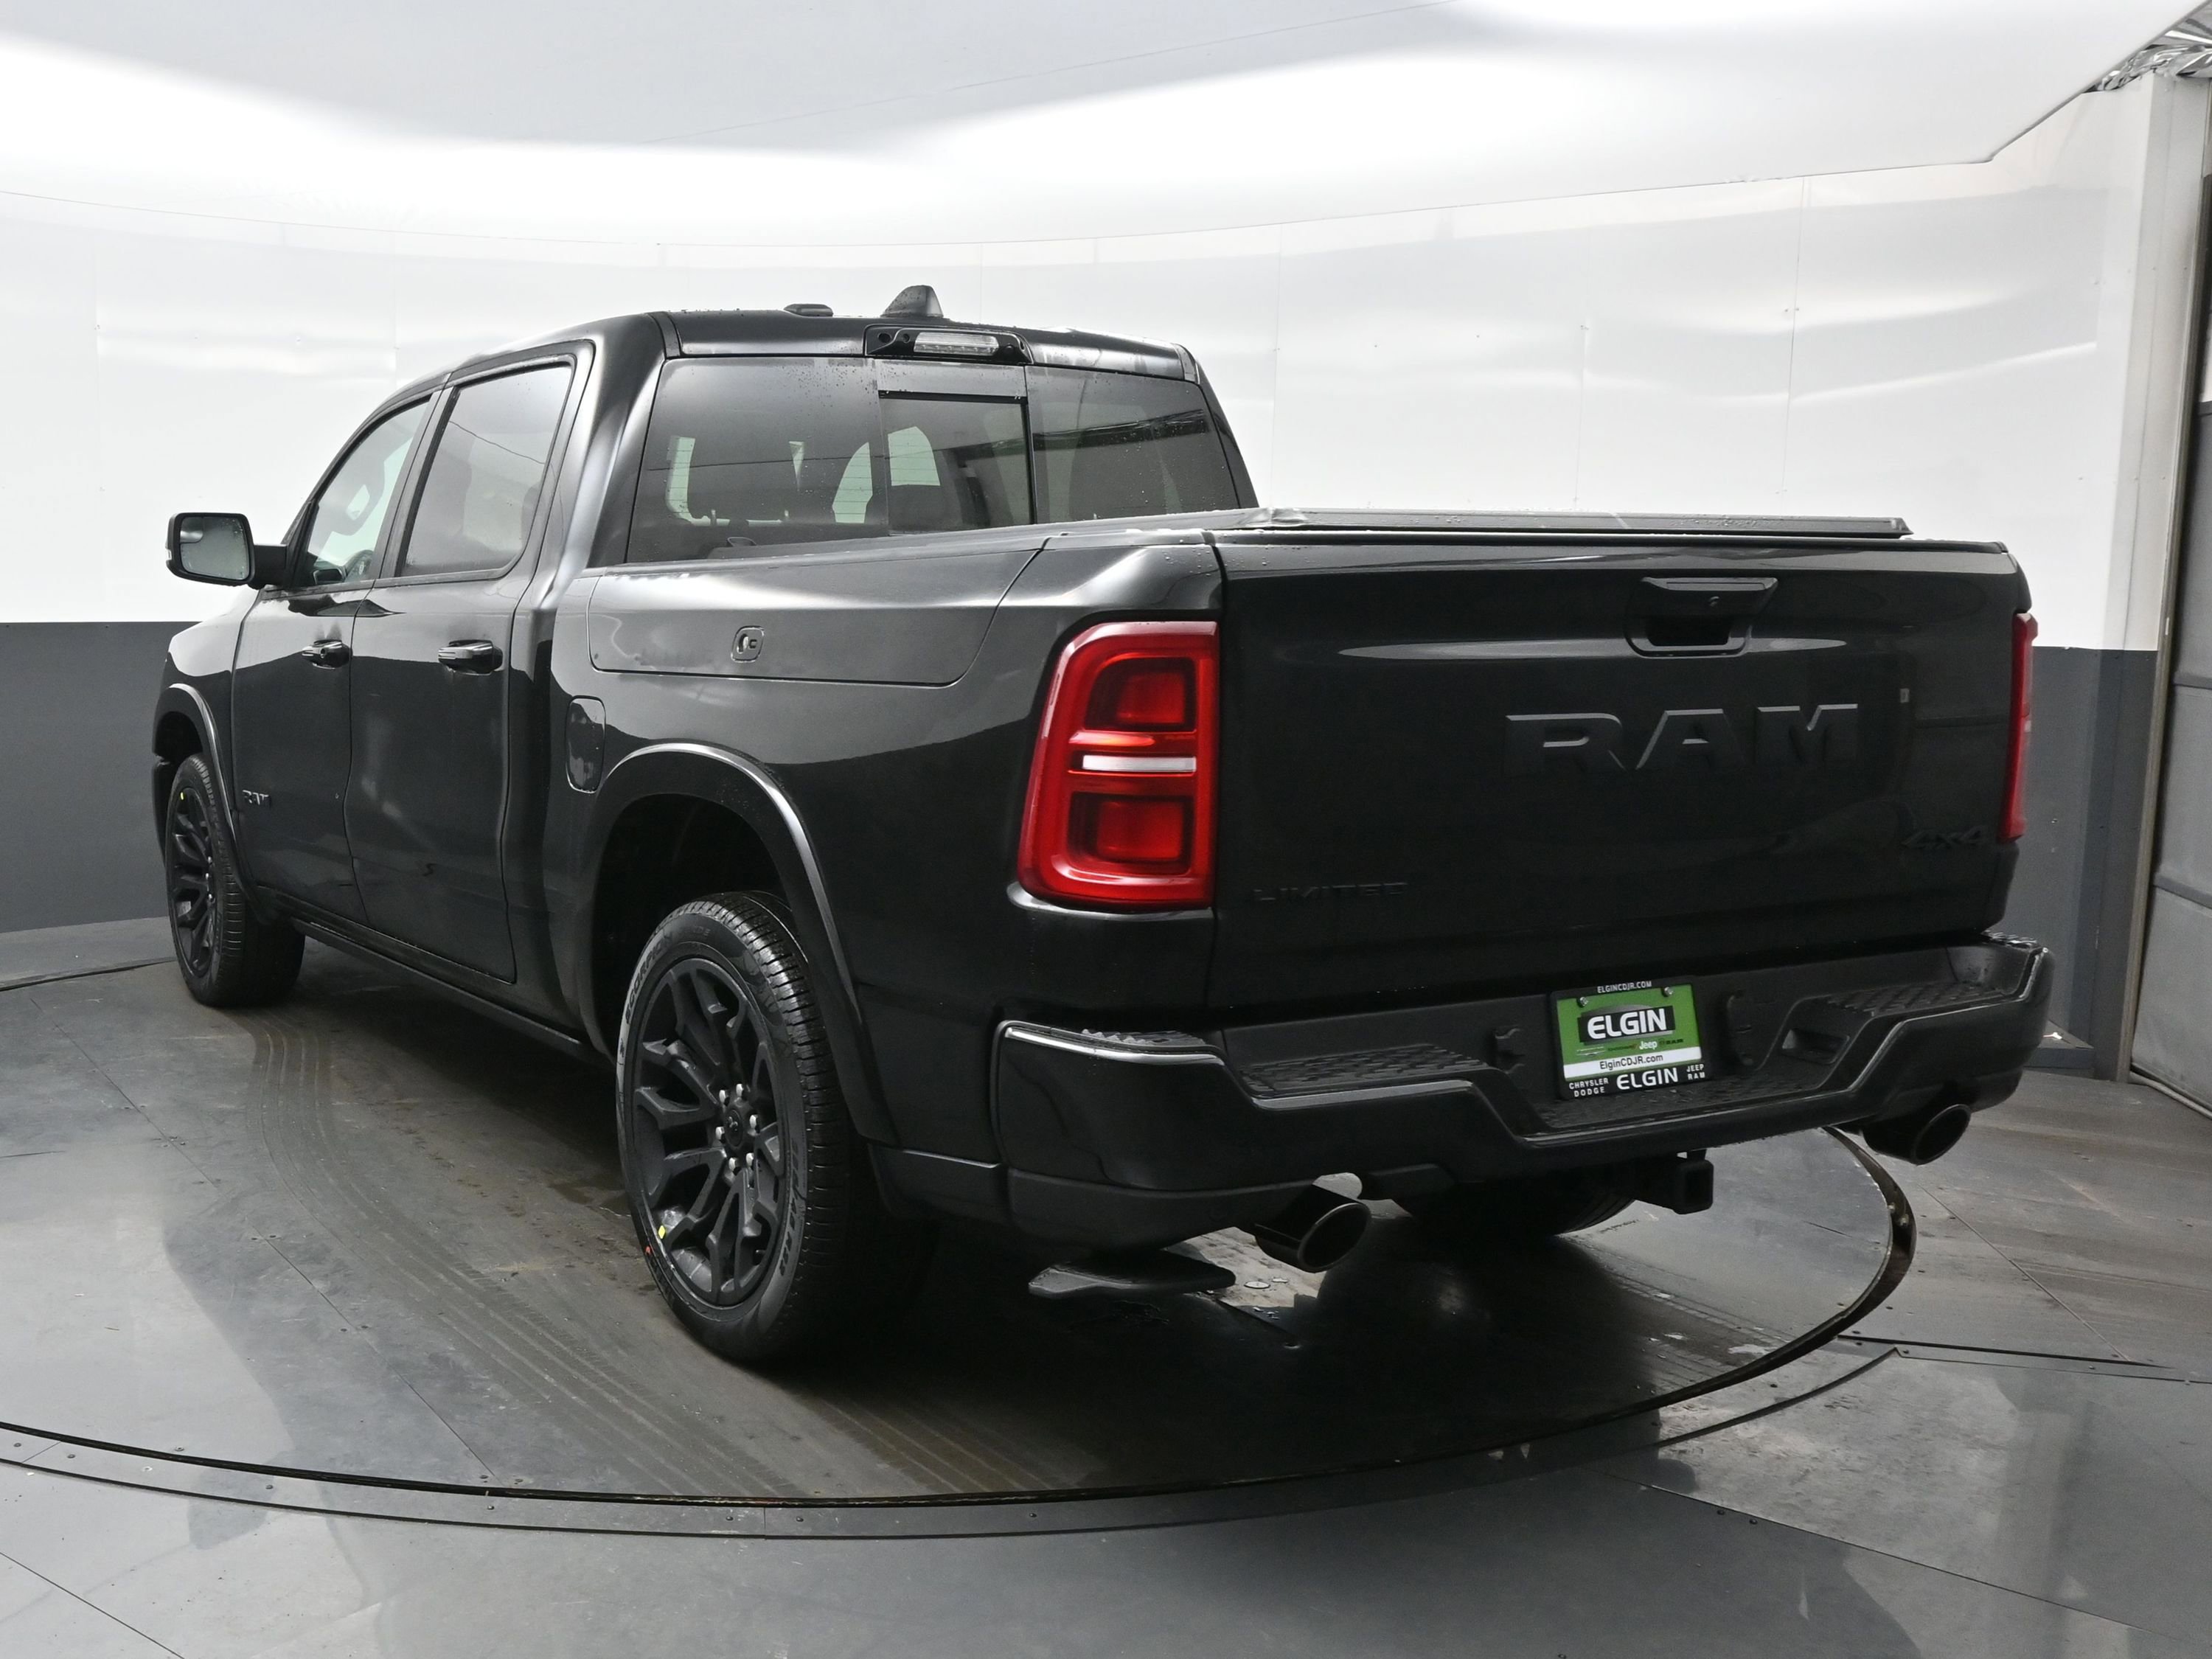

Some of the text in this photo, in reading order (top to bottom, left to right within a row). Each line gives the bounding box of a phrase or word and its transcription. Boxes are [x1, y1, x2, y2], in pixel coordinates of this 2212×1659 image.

[1503, 703, 1859, 777] RAM
[1253, 882, 1409, 902] LIMITED
[1596, 981, 1652, 994] ELGINCDJR.COM
[1587, 1008, 1667, 1040] ELGIN
[1639, 1040, 1658, 1051] Jeep
[1599, 1054, 1664, 1071] ElginCDJR.com
[1686, 1064, 1705, 1073] JEEP
[1616, 1067, 1679, 1091] ELGIN
[1687, 1071, 1706, 1081] RAM
[1568, 1077, 1610, 1091] CHRYSLER
[1573, 1086, 1606, 1098] DODGE
